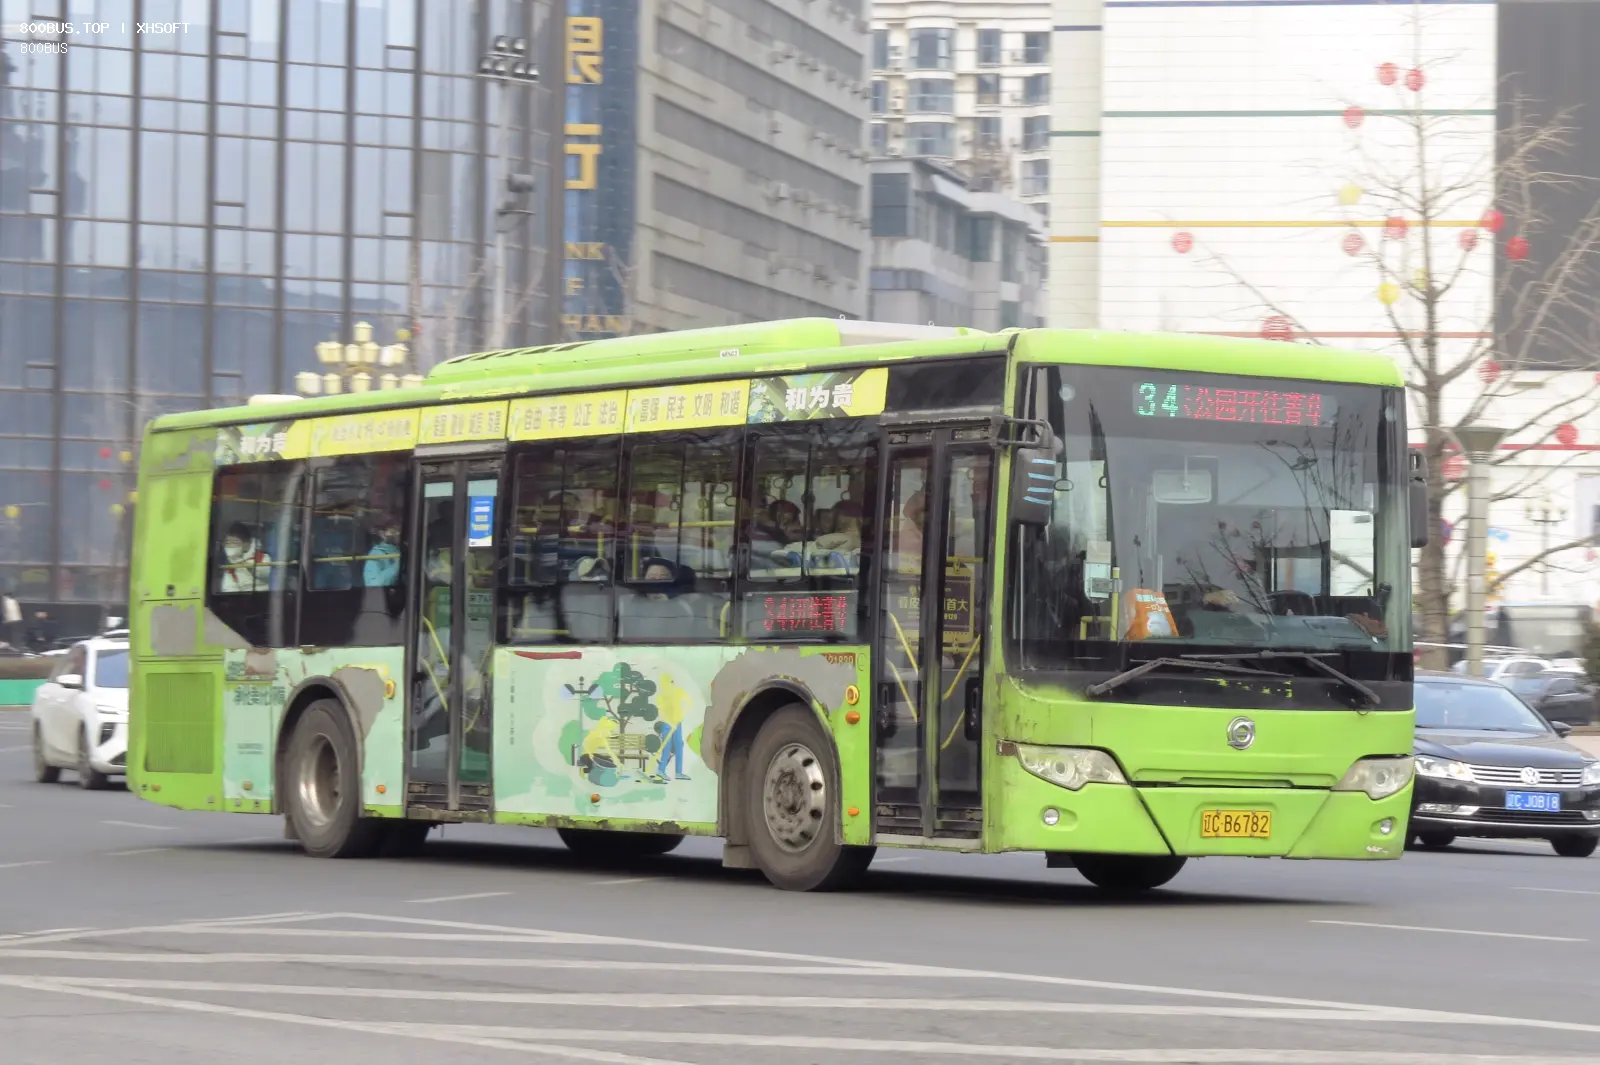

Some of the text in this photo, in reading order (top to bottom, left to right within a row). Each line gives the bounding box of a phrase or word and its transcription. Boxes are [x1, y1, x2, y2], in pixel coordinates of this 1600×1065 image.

[666, 395, 687, 421] 民主
[692, 392, 713, 417] 文明
[720, 389, 741, 416] 和谐
[785, 383, 853, 411] 和为贵
[1138, 382, 1179, 417] 34
